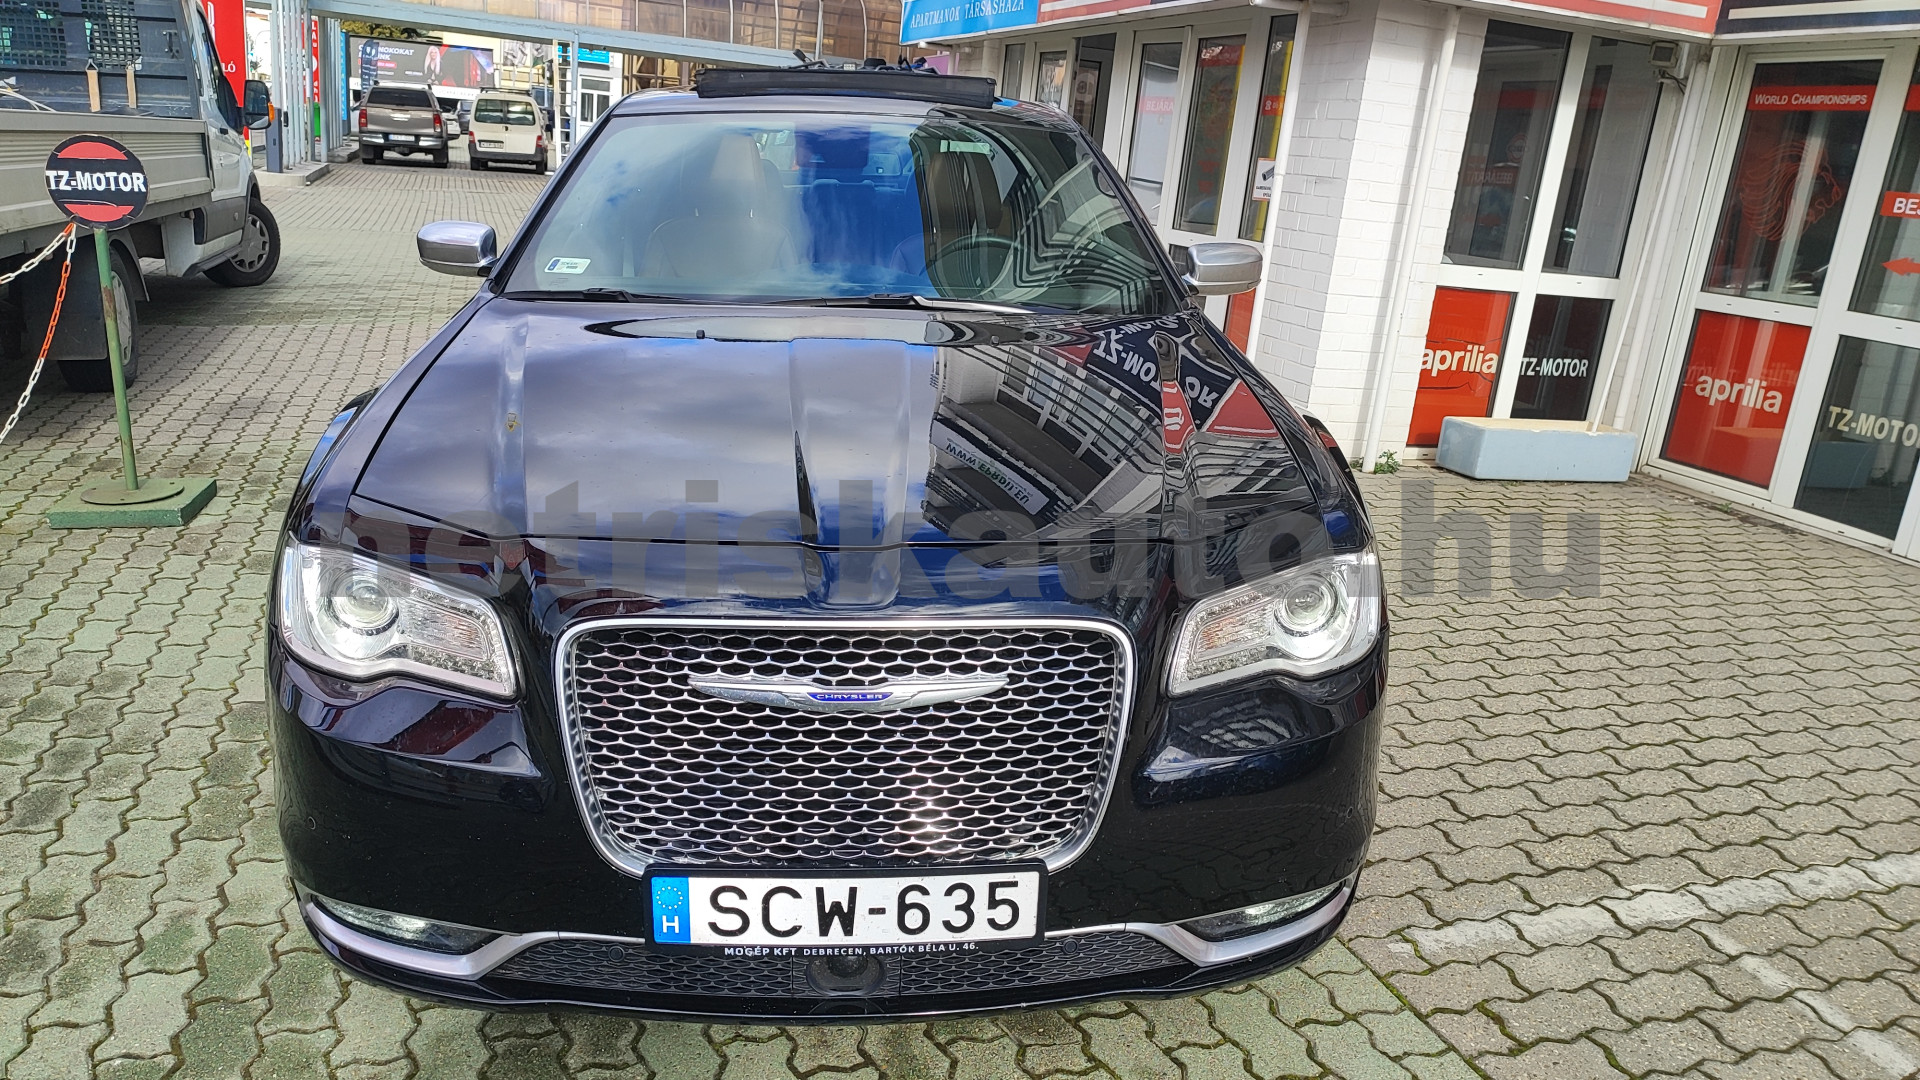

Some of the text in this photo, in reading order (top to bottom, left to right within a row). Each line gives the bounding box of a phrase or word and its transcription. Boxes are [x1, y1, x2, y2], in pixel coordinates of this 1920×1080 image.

[910, 6, 961, 29] APARTMANOK
[45, 170, 147, 192] TZ-MOTOR
[1421, 345, 1498, 377] aprilia
[1521, 357, 1589, 377] TZ-MOTOR
[1695, 375, 1783, 414] aprilia
[1828, 405, 1920, 448] TZ-MOTO
[708, 880, 1020, 938] SCW-635
[662, 915, 680, 934] H
[803, 948, 867, 956] DEBRECEN,
[870, 944, 915, 955] BARTÓK
[918, 943, 946, 952] BÉLA
[948, 943, 960, 951] U.
[962, 942, 979, 950] 46.
